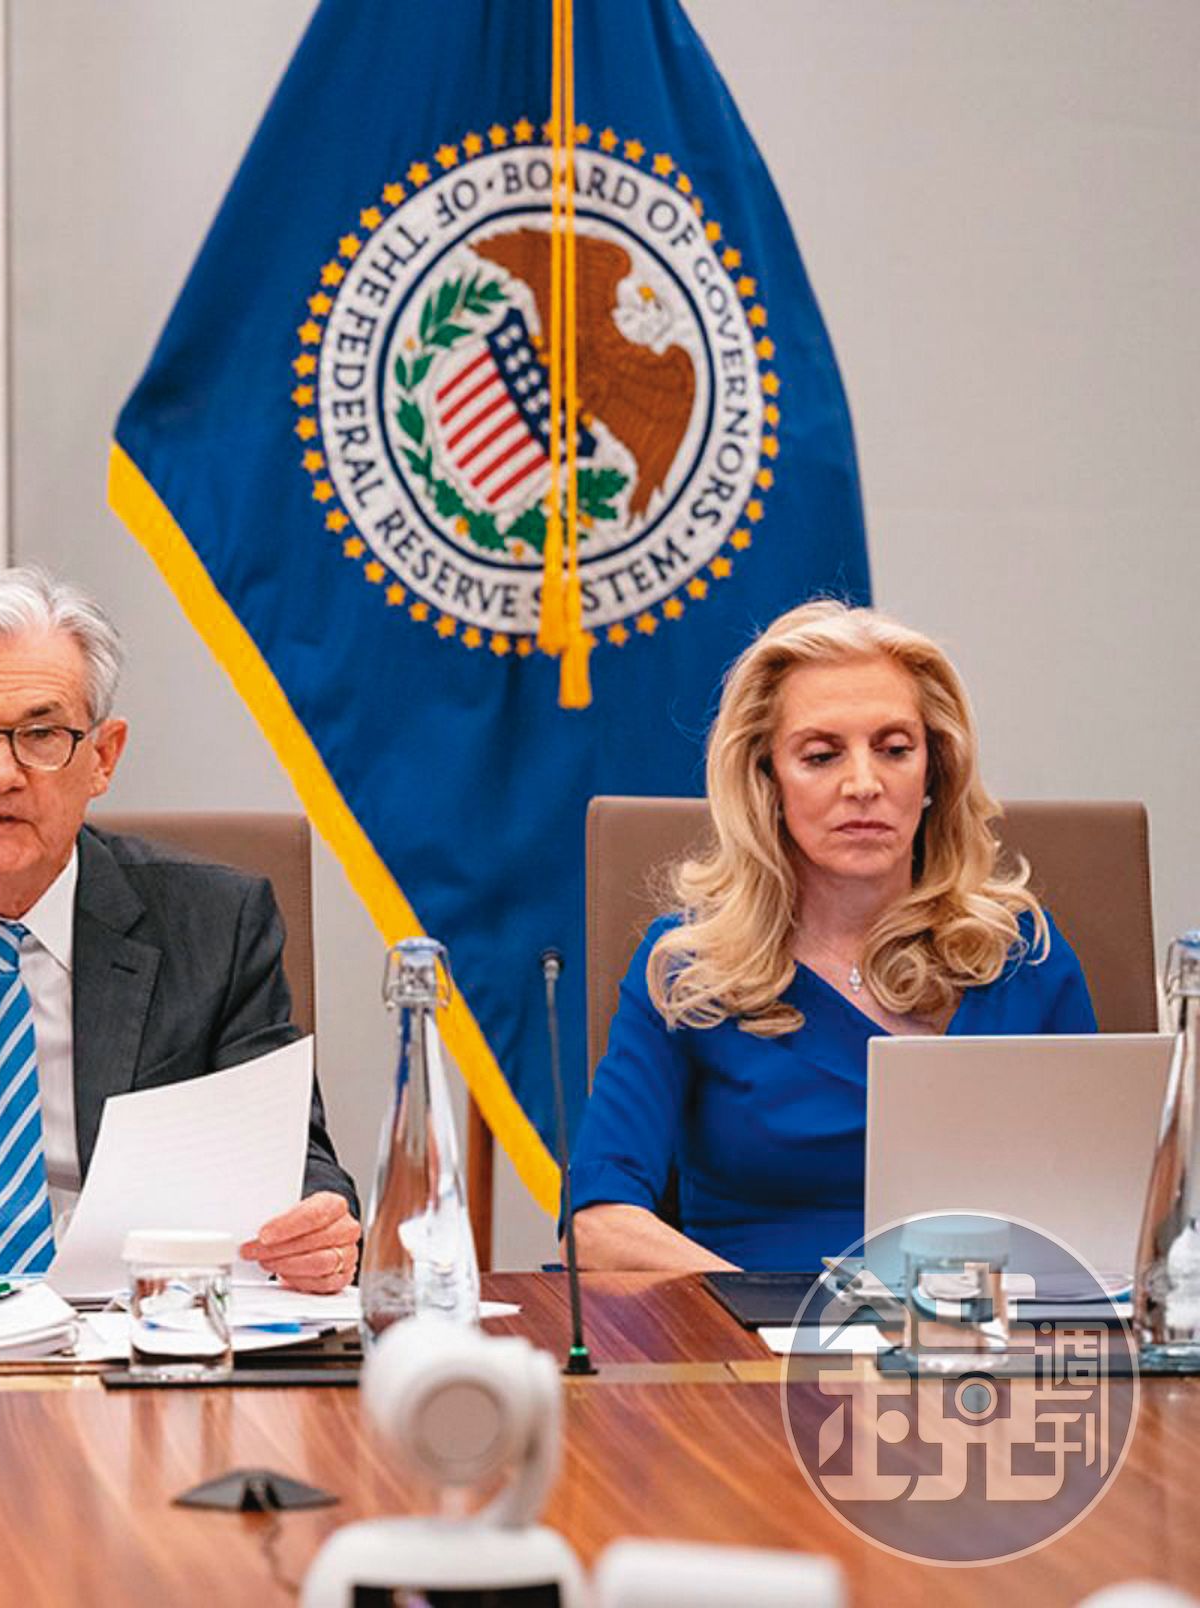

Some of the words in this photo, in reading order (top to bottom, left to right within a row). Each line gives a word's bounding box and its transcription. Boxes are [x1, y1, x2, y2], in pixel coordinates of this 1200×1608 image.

[435, 179, 479, 228] OF
[356, 224, 430, 307] THE
[332, 306, 385, 508] FEDERAL
[646, 199, 699, 247] OF
[690, 256, 749, 528] GOVERNORS
[374, 508, 520, 618] RESERVE
[531, 538, 689, 618] SSTEM
